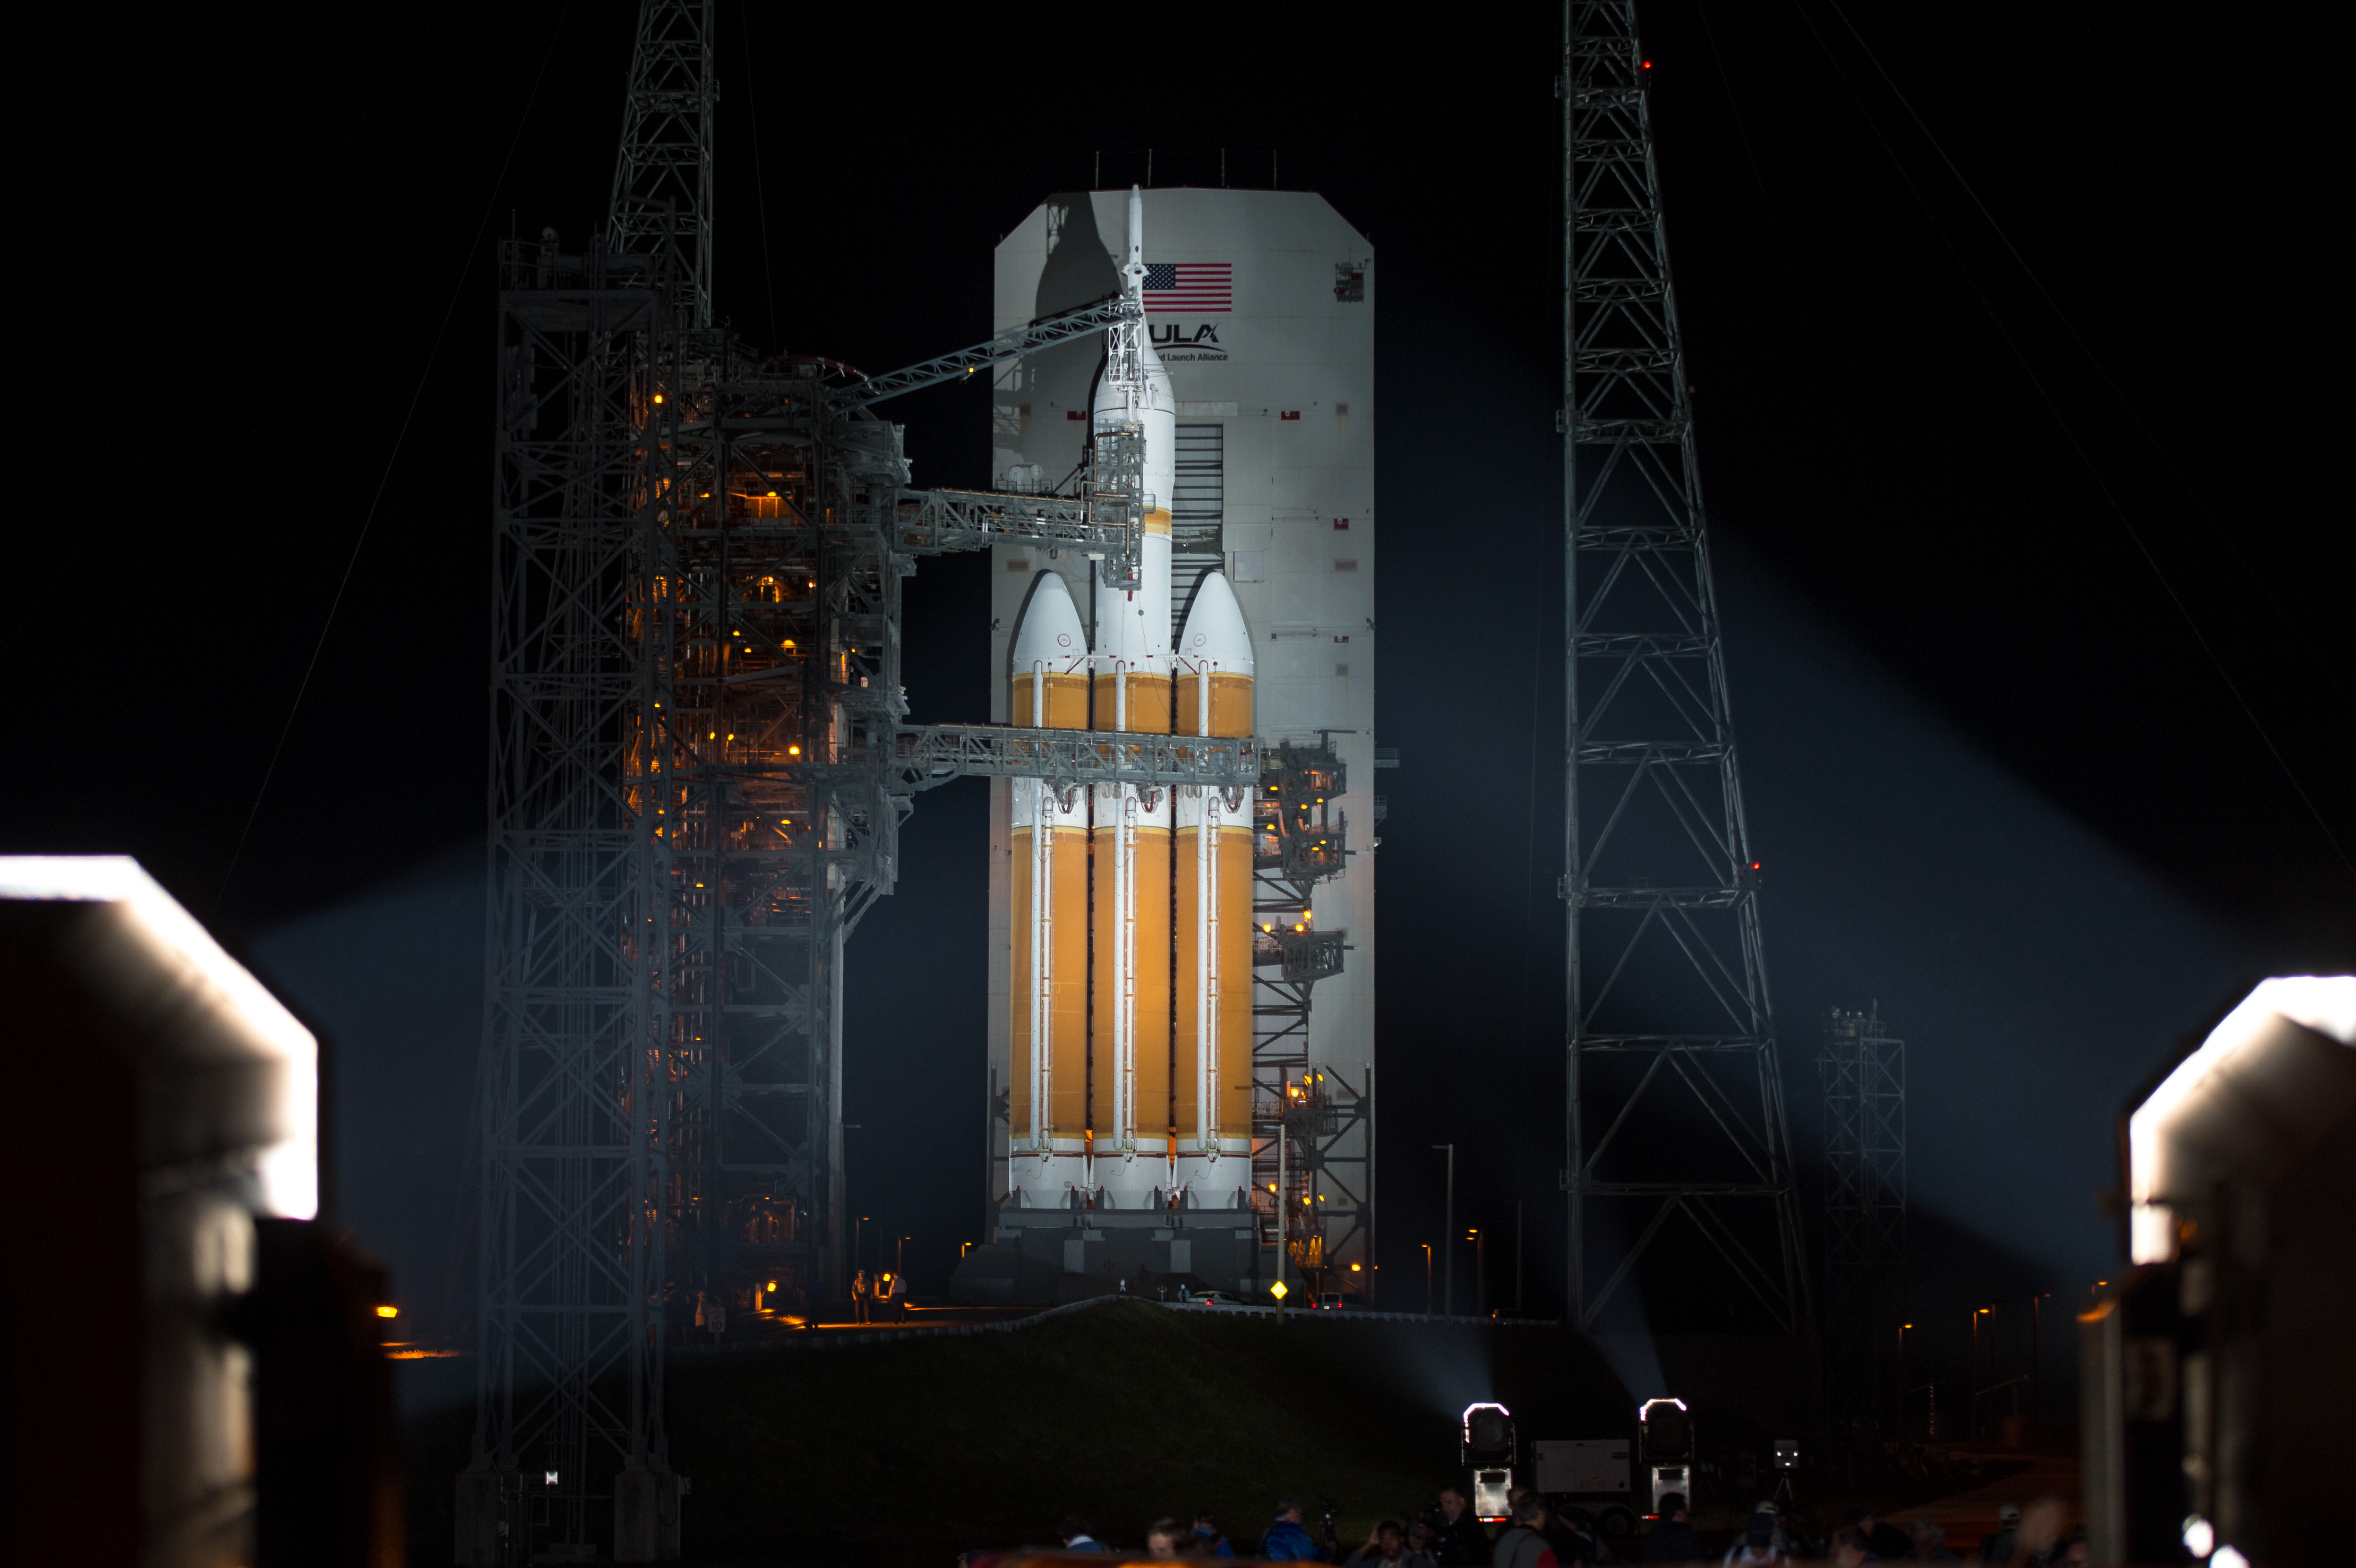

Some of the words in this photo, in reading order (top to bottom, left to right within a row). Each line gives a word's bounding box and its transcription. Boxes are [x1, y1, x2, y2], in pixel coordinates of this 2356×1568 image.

[1149, 323, 1220, 343] ULA
[1167, 353, 1195, 362] Launch
[1197, 353, 1228, 362] Alliance
[712, 1321, 723, 1330] 10
